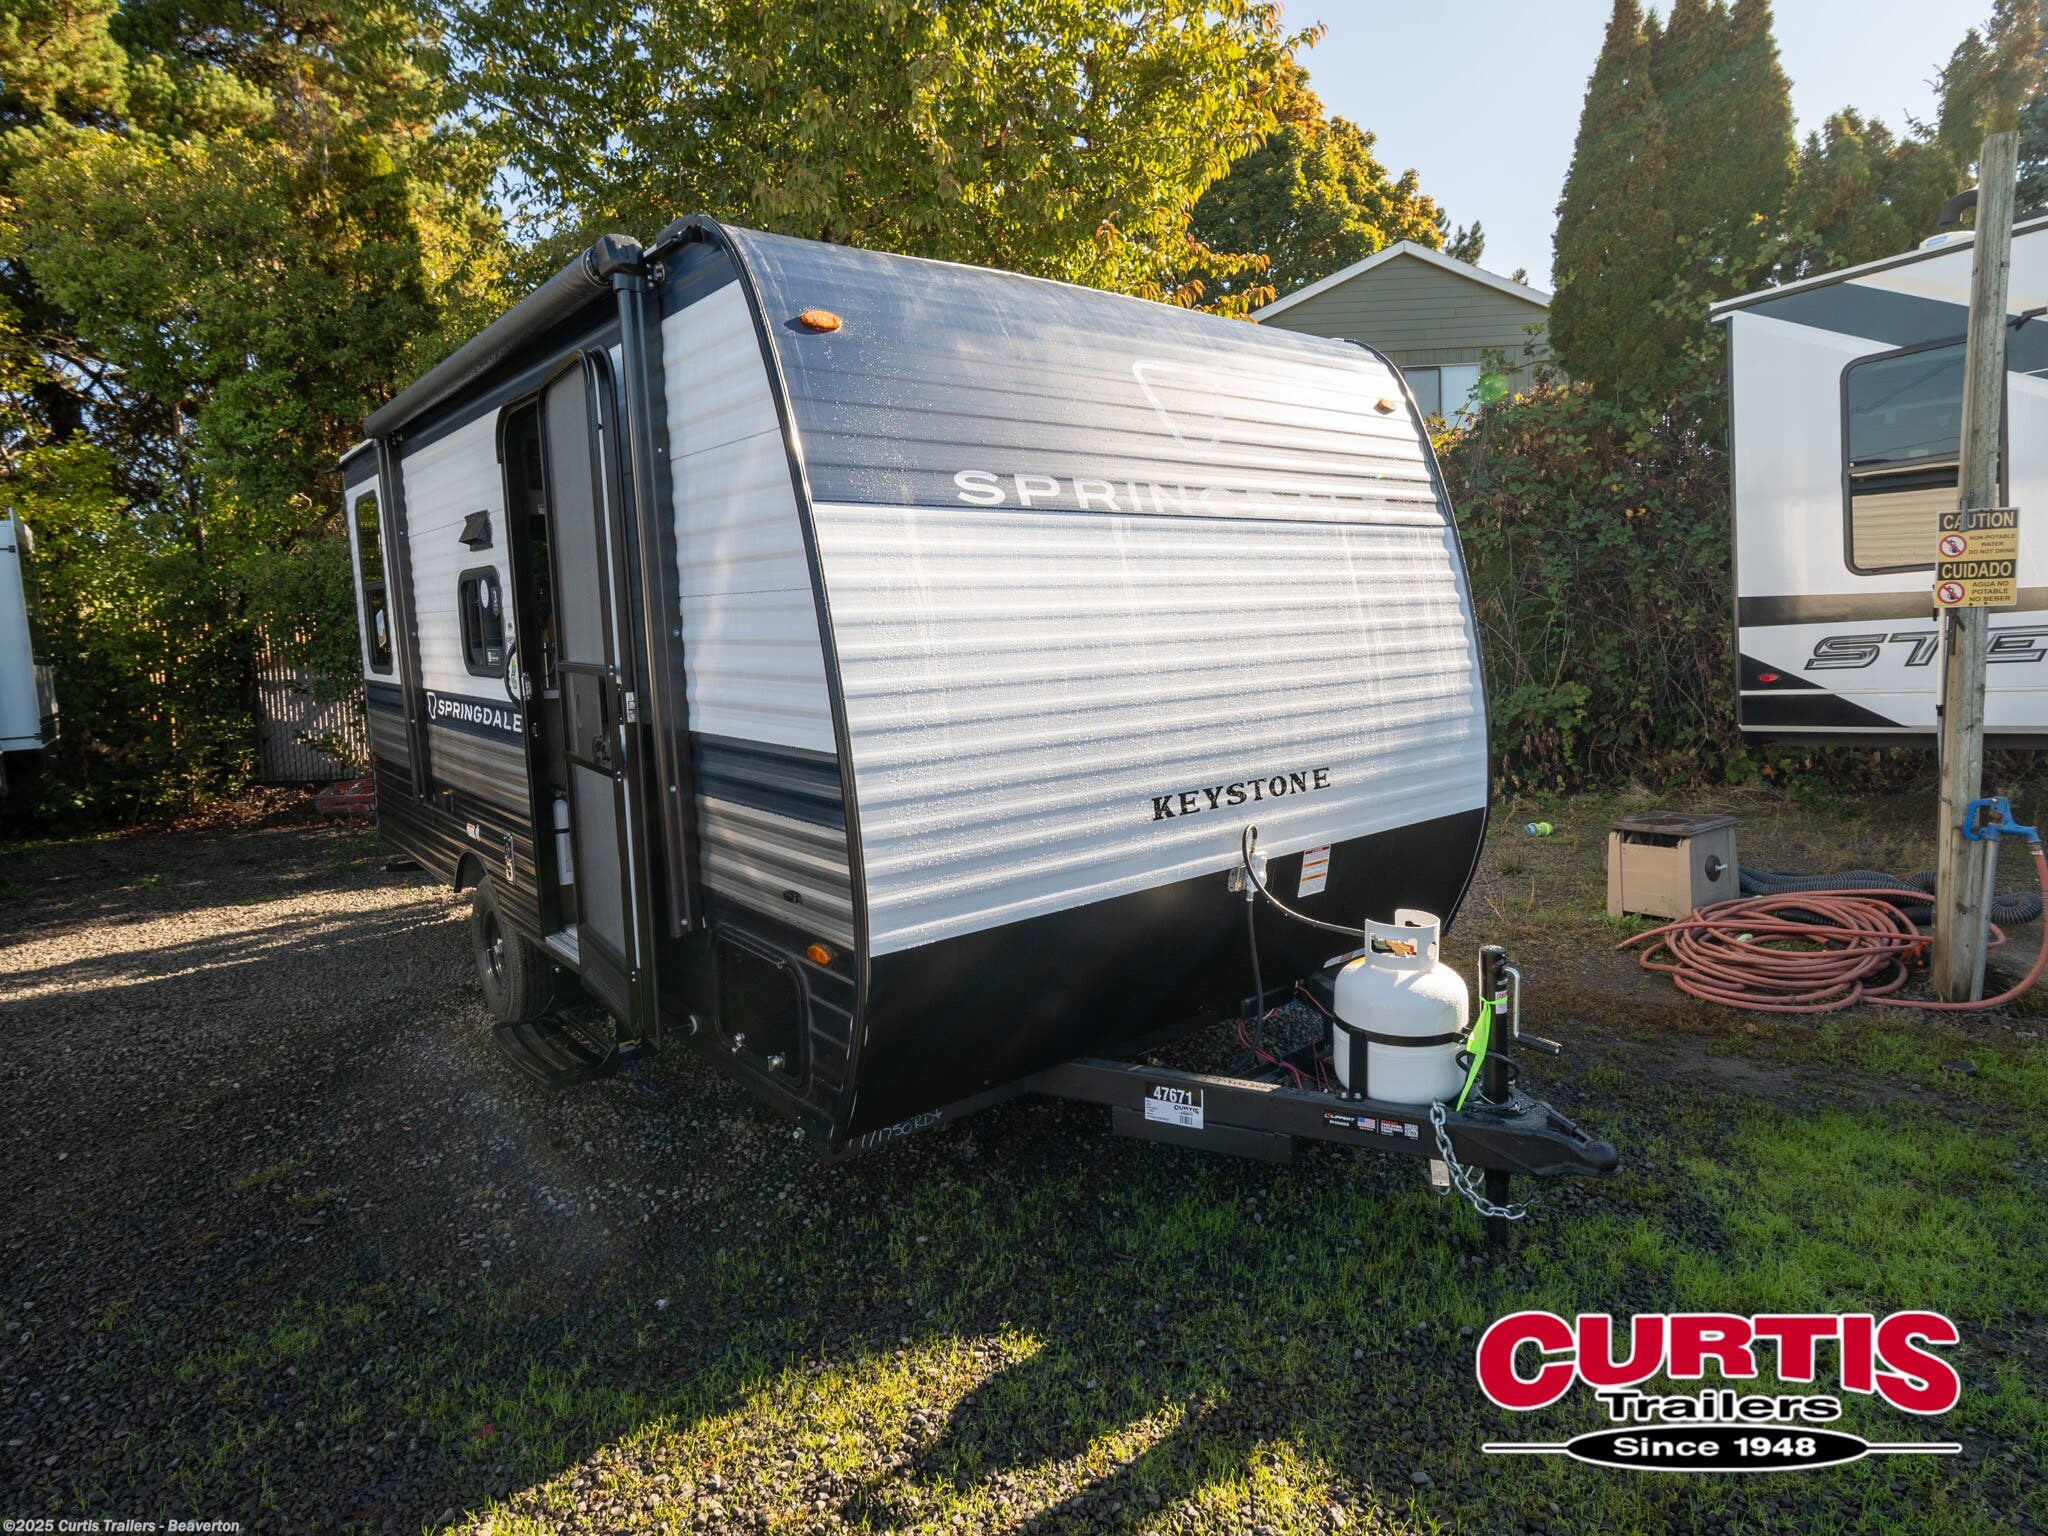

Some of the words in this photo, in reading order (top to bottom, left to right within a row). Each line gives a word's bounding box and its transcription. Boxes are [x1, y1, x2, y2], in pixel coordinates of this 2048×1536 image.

[1942, 561, 2012, 579] CUIDADO
[437, 699, 522, 733] SPRINGDALE
[1151, 767, 1331, 821] KEYSTONE
[1153, 1085, 1192, 1106] 47671
